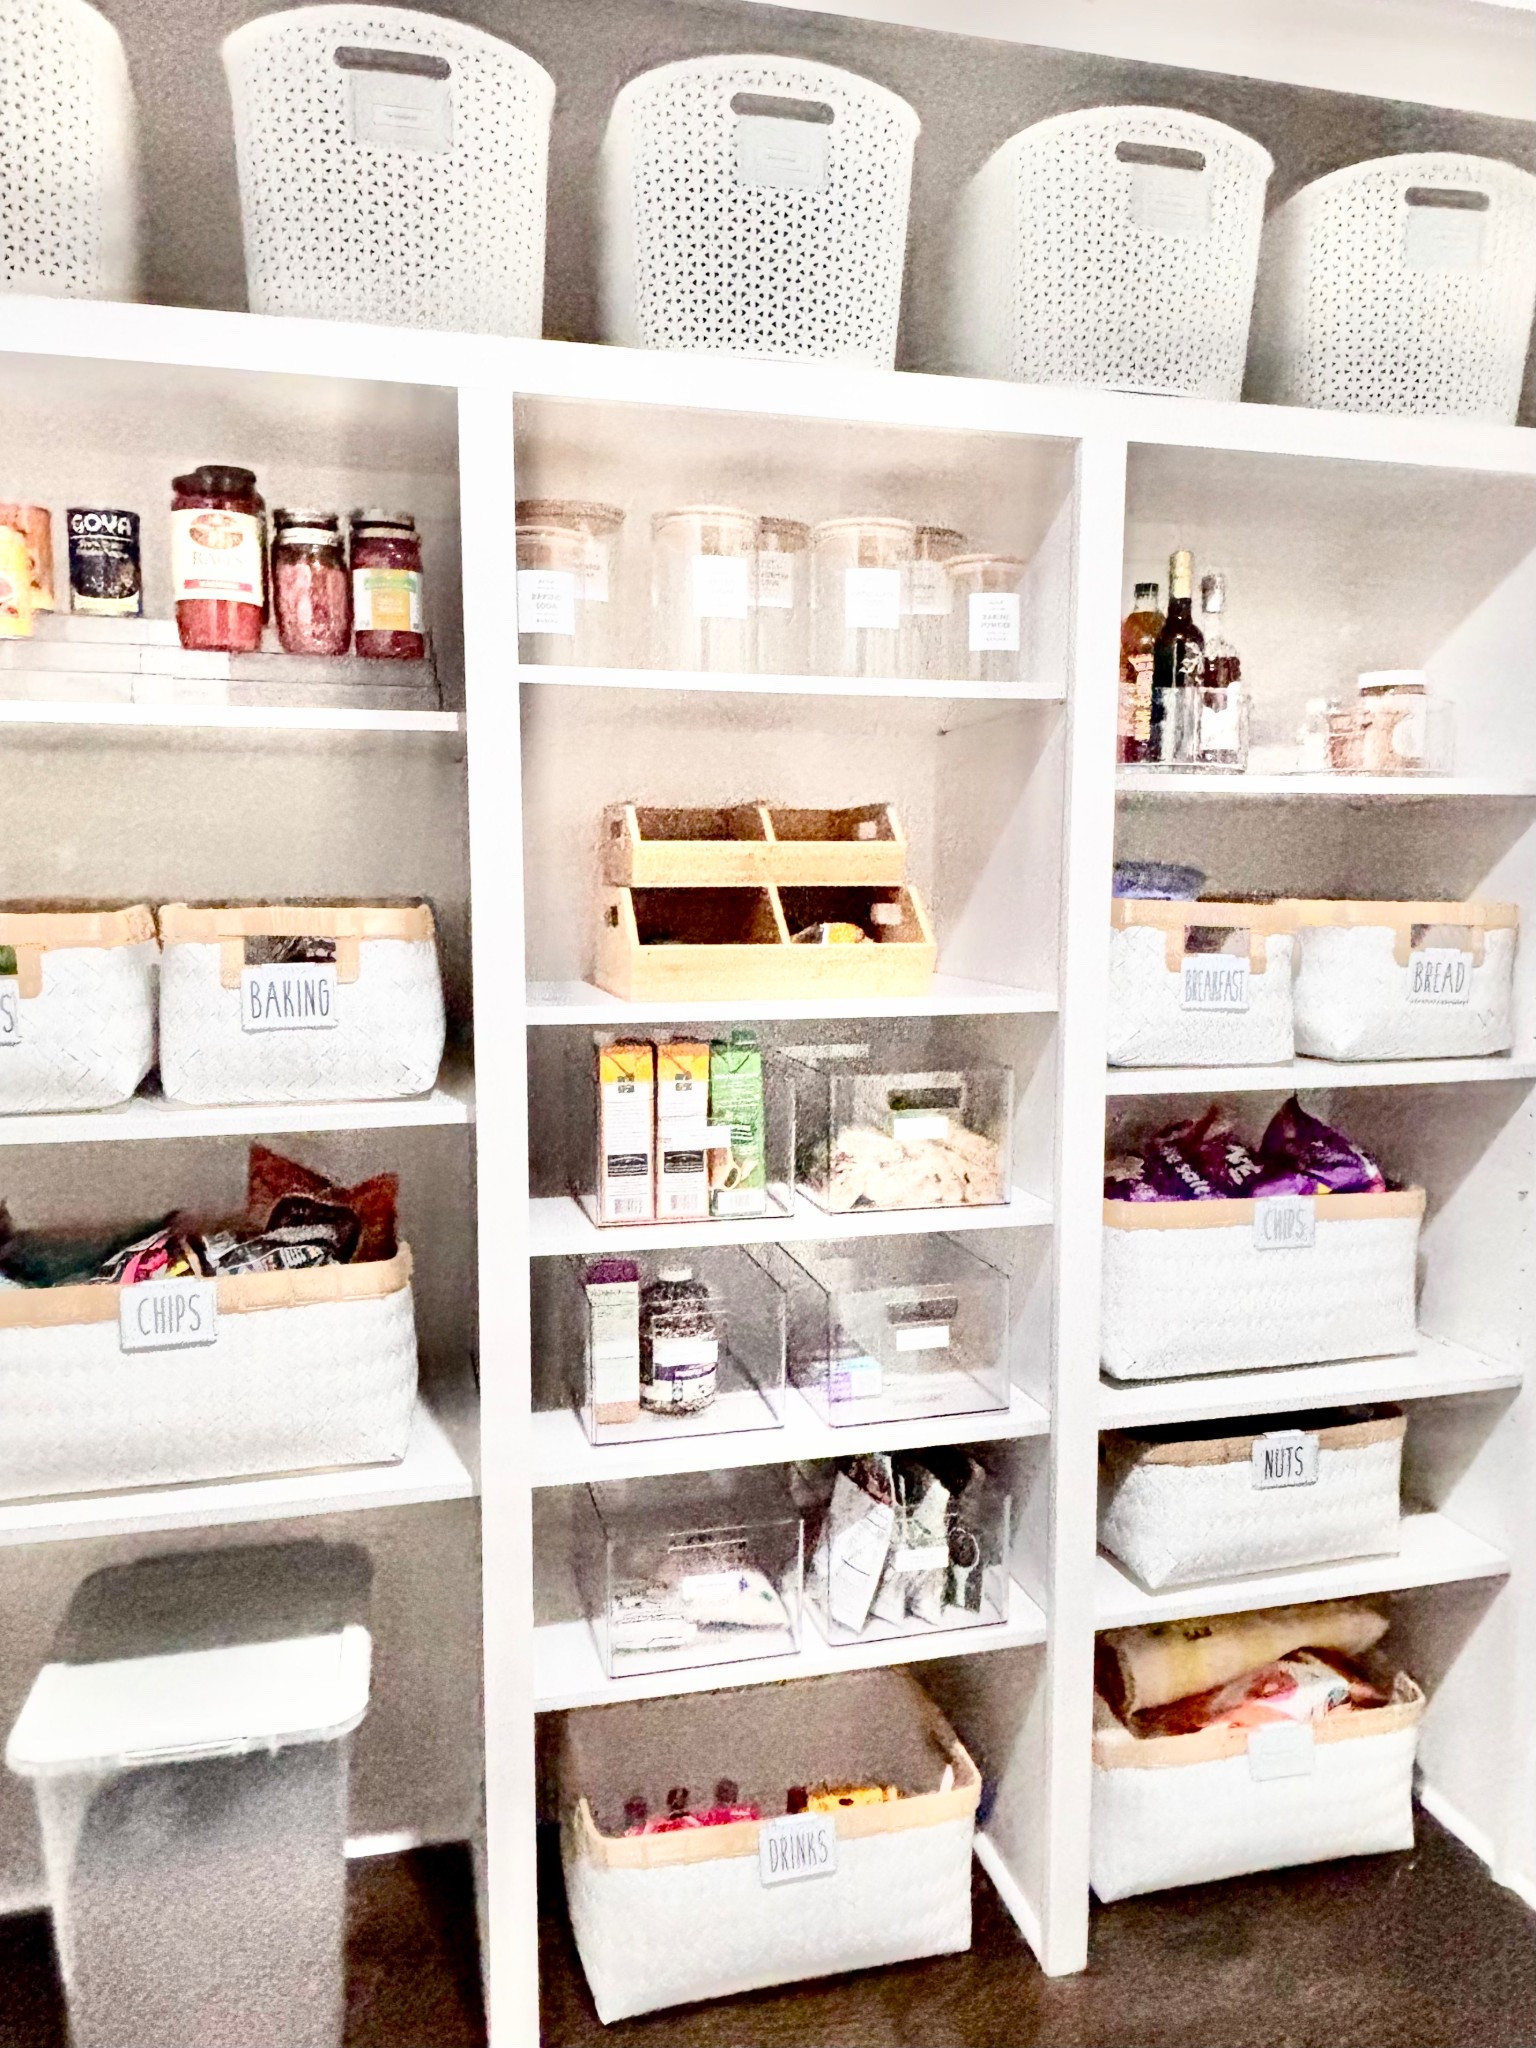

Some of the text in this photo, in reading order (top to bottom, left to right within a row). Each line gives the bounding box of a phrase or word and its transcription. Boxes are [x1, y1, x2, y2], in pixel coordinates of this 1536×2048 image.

[70, 513, 133, 536] GOYA
[1413, 961, 1466, 994] BREAD
[249, 979, 331, 1019] BAKING
[1263, 1207, 1306, 1241] CHIPS
[137, 1294, 202, 1336] CHIPS
[1264, 1446, 1304, 1478] NUTS
[769, 1829, 829, 1873] DRINKS
